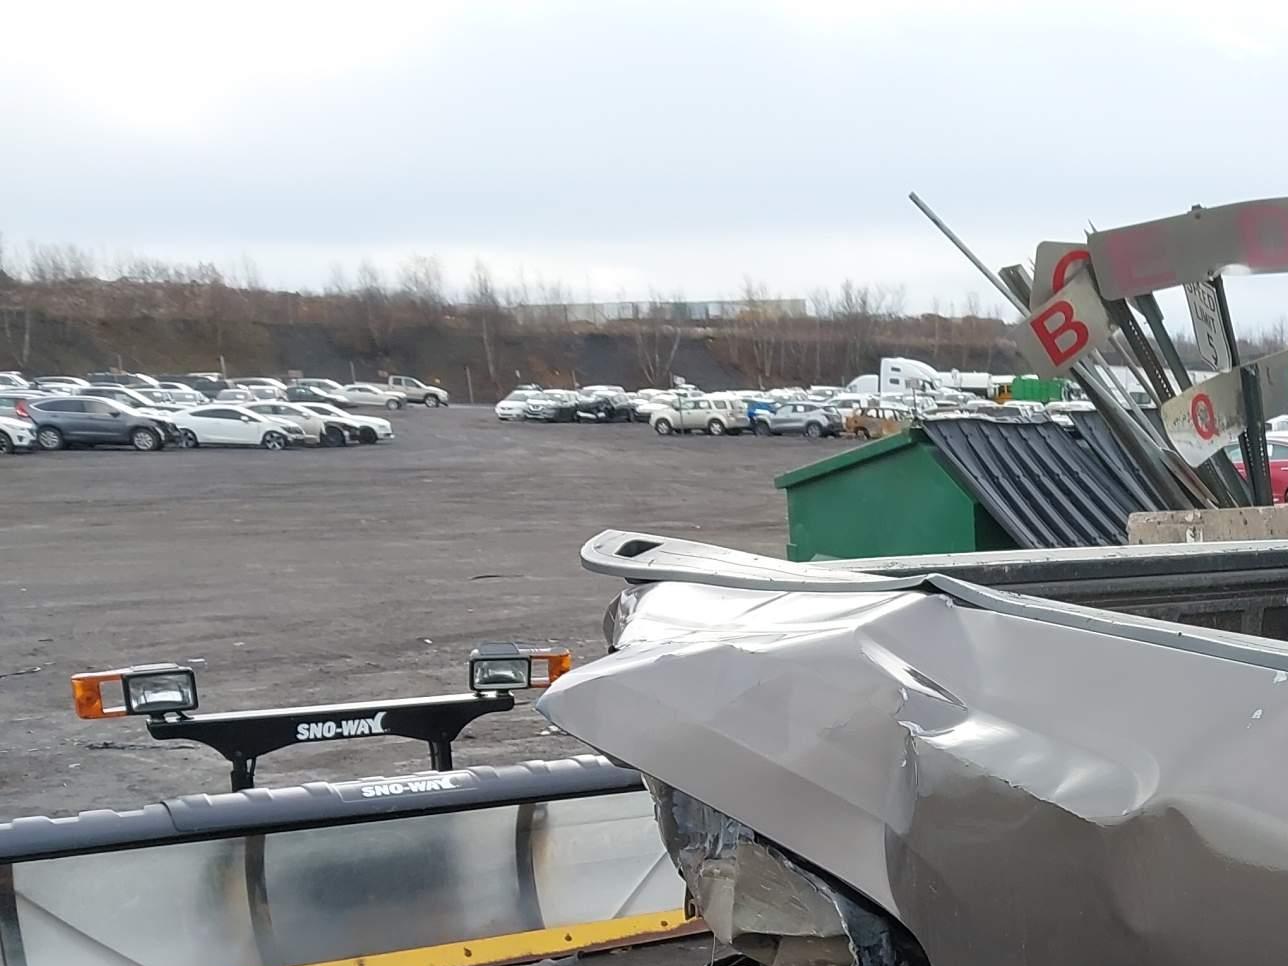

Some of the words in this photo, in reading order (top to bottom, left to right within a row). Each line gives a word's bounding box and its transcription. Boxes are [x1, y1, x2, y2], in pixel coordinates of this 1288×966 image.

[1030, 300, 1089, 367] B
[1191, 392, 1221, 441] Q
[296, 711, 388, 740] SNO-WAY
[361, 776, 458, 798] SNO-WAY
